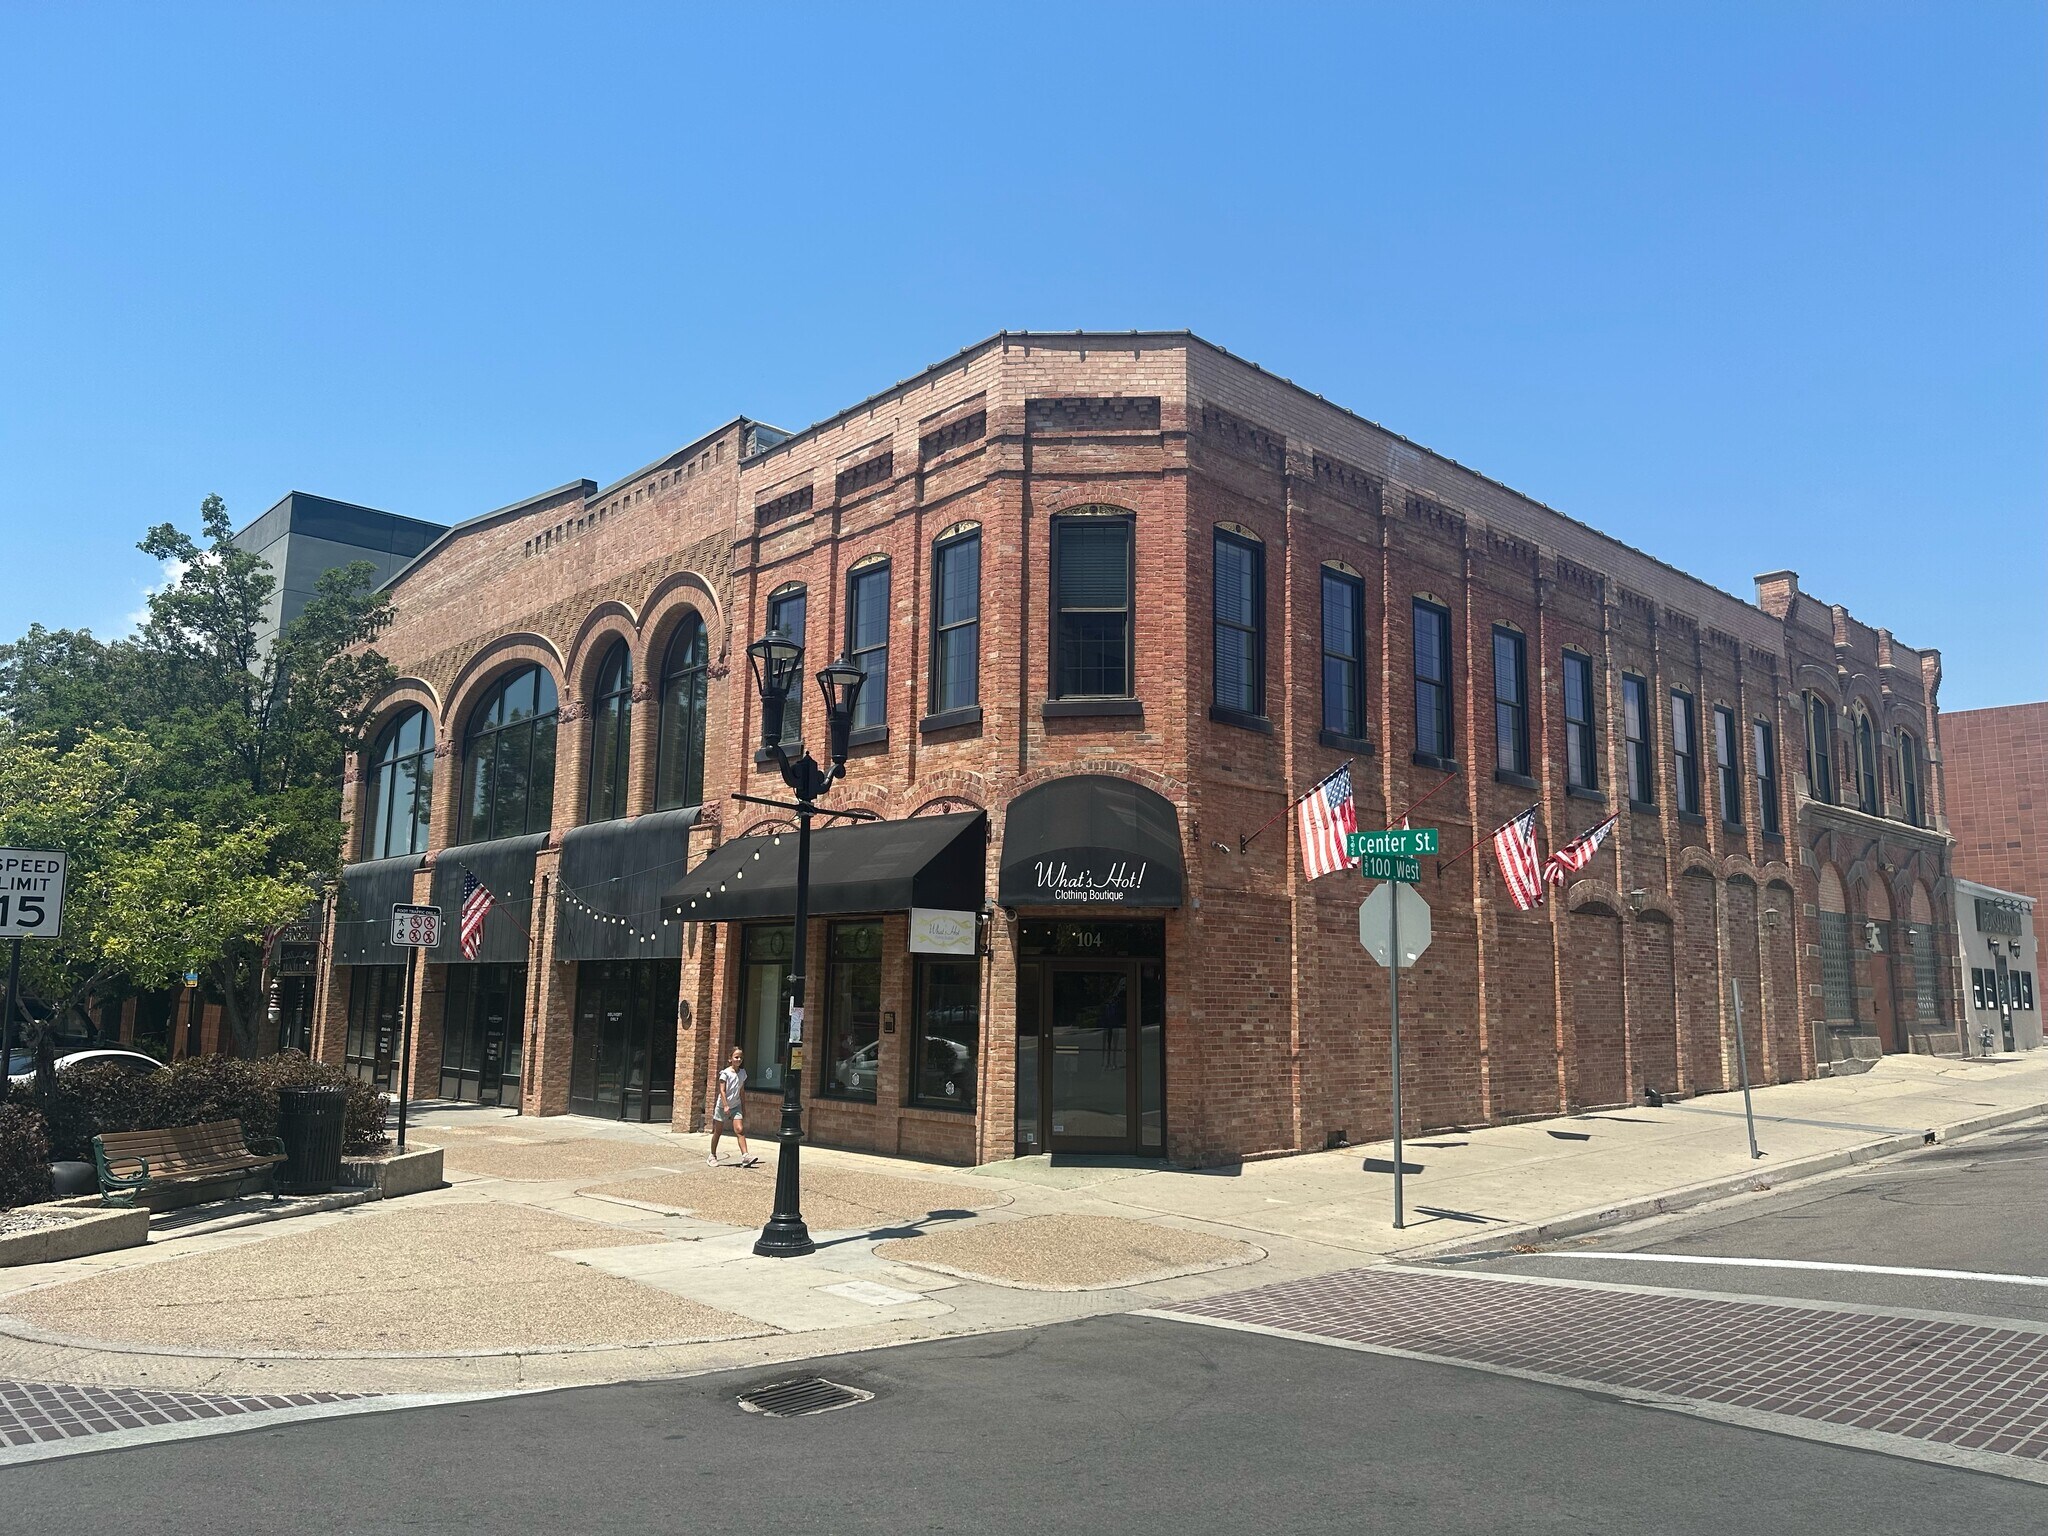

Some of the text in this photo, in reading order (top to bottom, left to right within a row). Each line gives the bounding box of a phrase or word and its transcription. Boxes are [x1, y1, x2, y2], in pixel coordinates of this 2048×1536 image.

[1359, 832, 1435, 854] Center St.
[1034, 861, 1147, 889] What's Hot!
[1370, 857, 1420, 880] 100 West
[1055, 889, 1124, 902] Clothing Boutique
[0, 895, 45, 927] 15
[1076, 931, 1104, 947] 104
